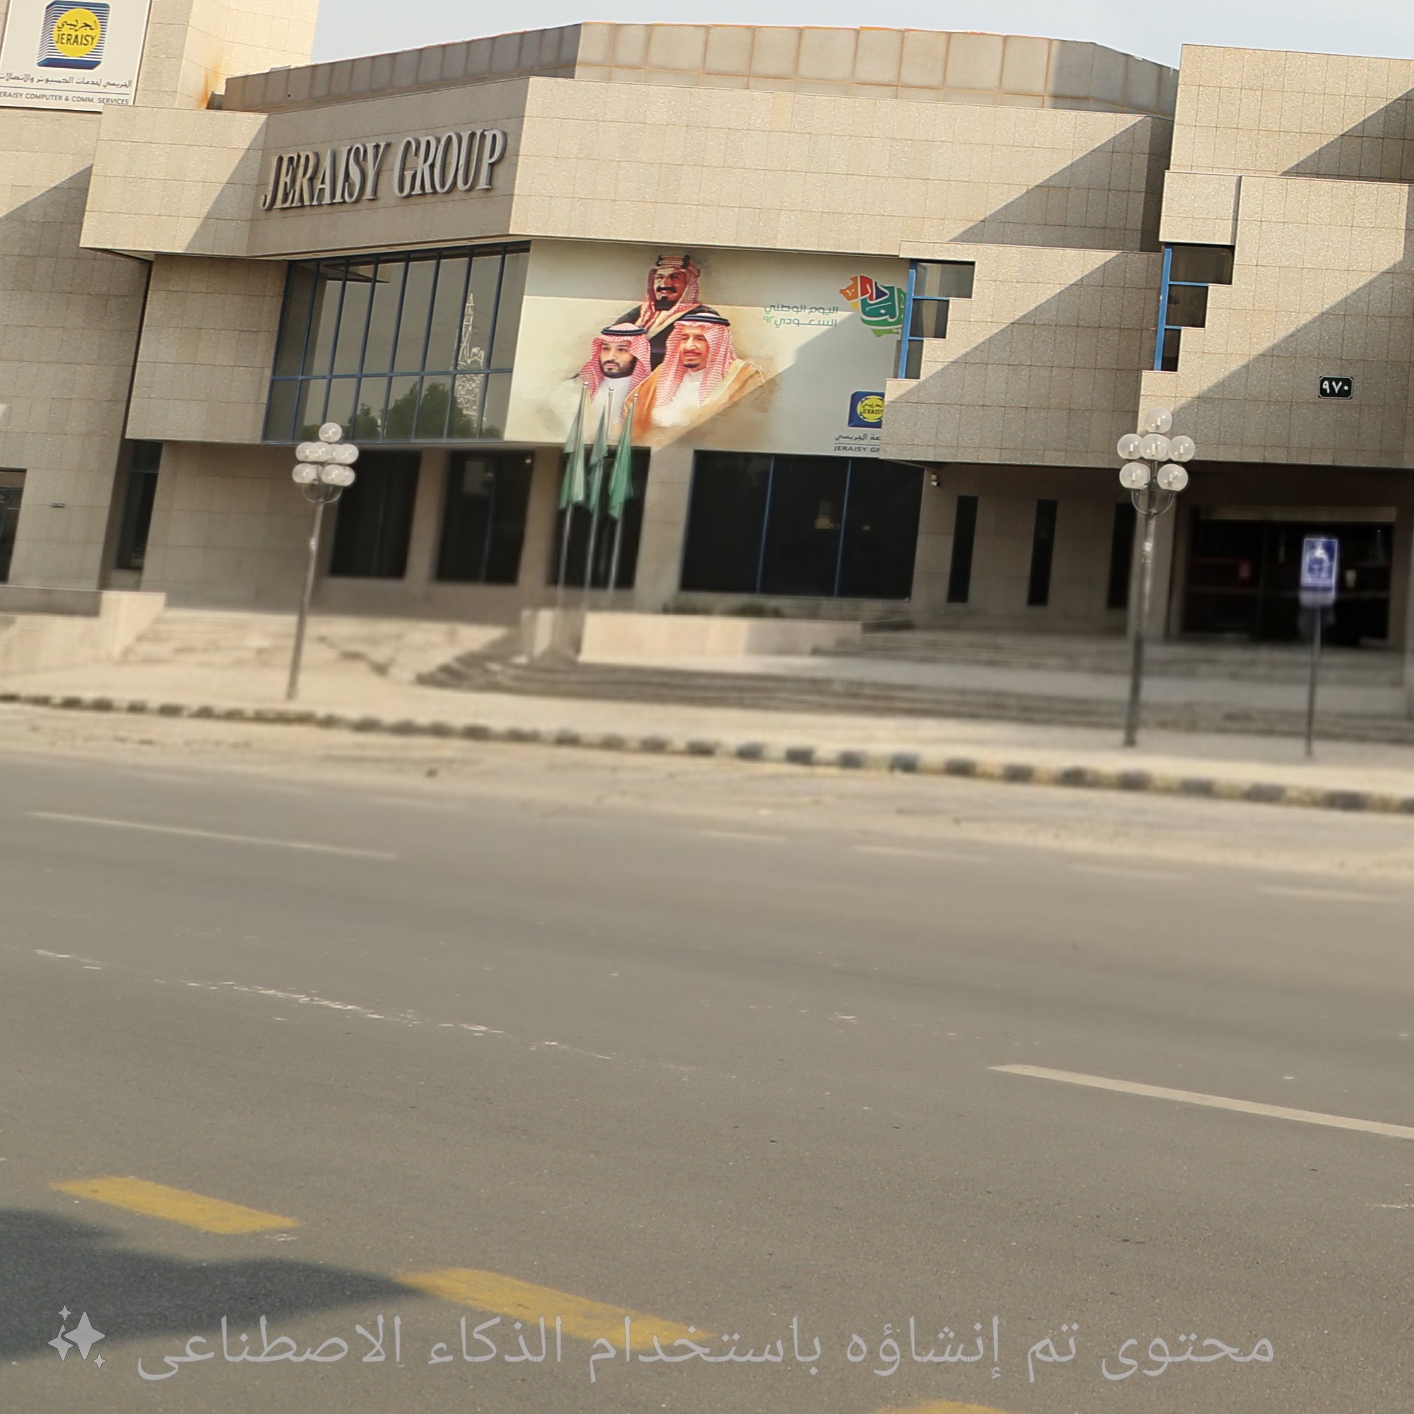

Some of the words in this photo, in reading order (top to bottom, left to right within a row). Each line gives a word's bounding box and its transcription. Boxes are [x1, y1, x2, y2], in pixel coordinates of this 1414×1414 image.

[55, 33, 97, 46] JERAISY
[25, 92, 63, 100] COMPUTER
[97, 97, 129, 105] SERVICES
[260, 141, 391, 211] JERAISY
[393, 128, 508, 198] GROUP
[1322, 380, 1349, 394] ٩٧٠
